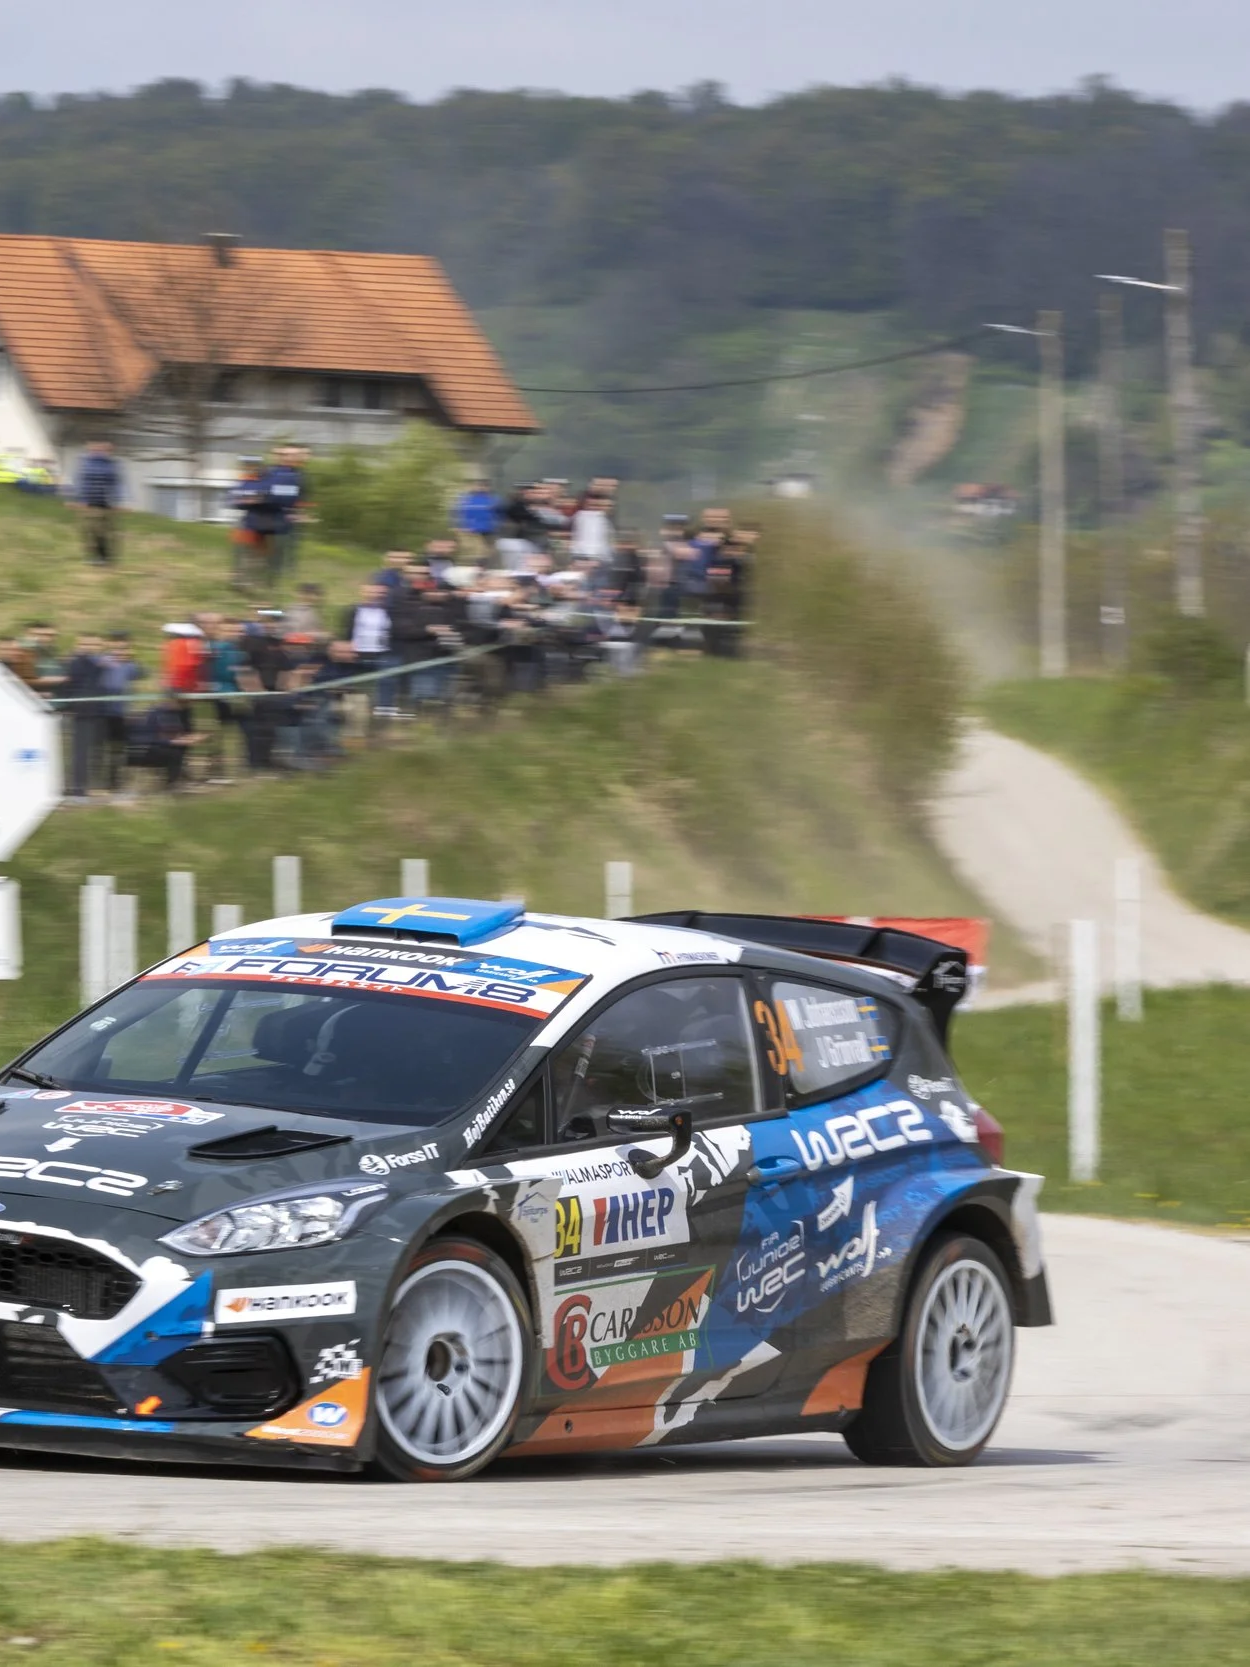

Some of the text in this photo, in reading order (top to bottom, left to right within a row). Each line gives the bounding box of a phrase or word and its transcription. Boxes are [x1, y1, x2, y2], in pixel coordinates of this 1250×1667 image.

[225, 958, 537, 1004] FORUM8
[753, 999, 805, 1076] 34
[790, 1100, 933, 1171] WRC2
[554, 1197, 581, 1257] 34
[621, 1187, 675, 1242] HEP
[594, 1332, 697, 1366] BYGGARE AB
